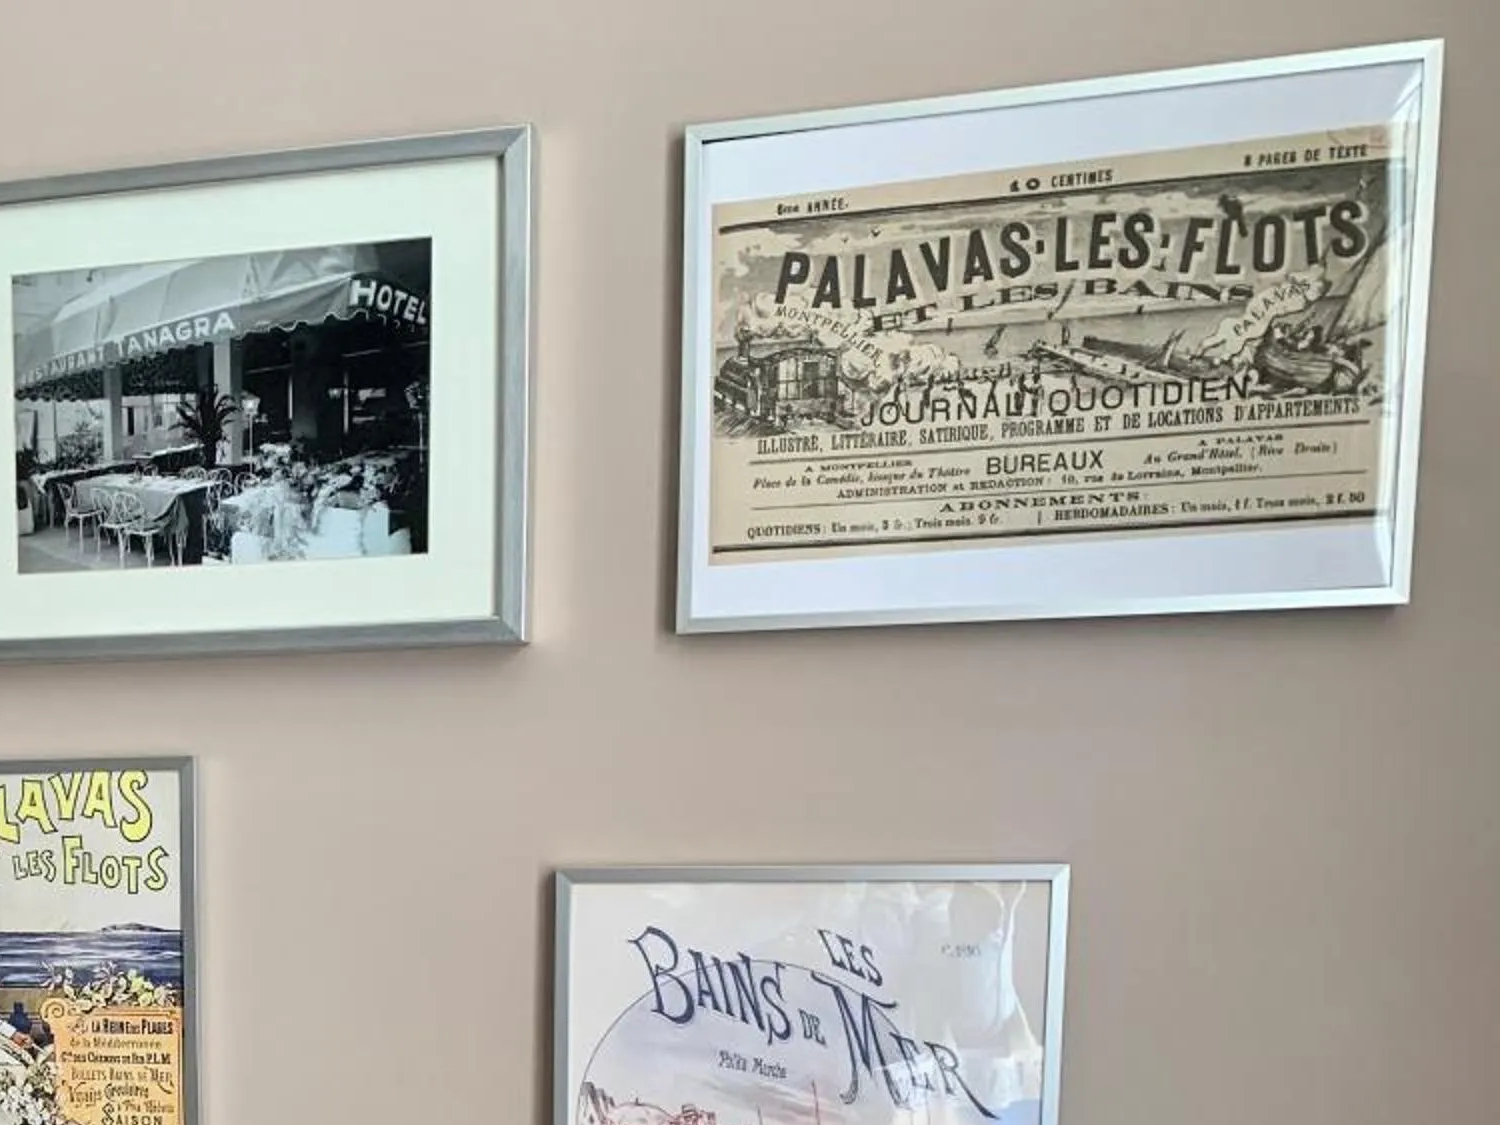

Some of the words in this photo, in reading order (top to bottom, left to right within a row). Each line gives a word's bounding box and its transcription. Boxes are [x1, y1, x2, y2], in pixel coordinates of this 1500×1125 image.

[1304, 148, 1319, 162] DE
[1051, 169, 1113, 188] CENTIMES
[349, 279, 428, 324] HOTEL
[113, 311, 236, 357] TANAGRA
[774, 305, 883, 369] MONTPELLIER
[861, 391, 1023, 427] JOURNAL
[1048, 376, 1250, 417] QUOTIDIEN
[1001, 418, 1084, 440] PROGRAMME
[1093, 415, 1112, 432] ET
[1123, 413, 1141, 429] DE
[1149, 405, 1224, 428] LOCATIONS
[1234, 398, 1360, 422] D'APPARTEMENTS
[785, 477, 797, 487] de
[986, 449, 1104, 476] BUREAUX
[836, 483, 947, 500] ADMINISTRATION
[12, 849, 56, 881] LES
[62, 833, 169, 895] FLOTS
[818, 929, 885, 987] LES
[628, 925, 797, 1047] BAINS
[799, 1008, 827, 1046] DE
[811, 971, 1001, 1121] MER
